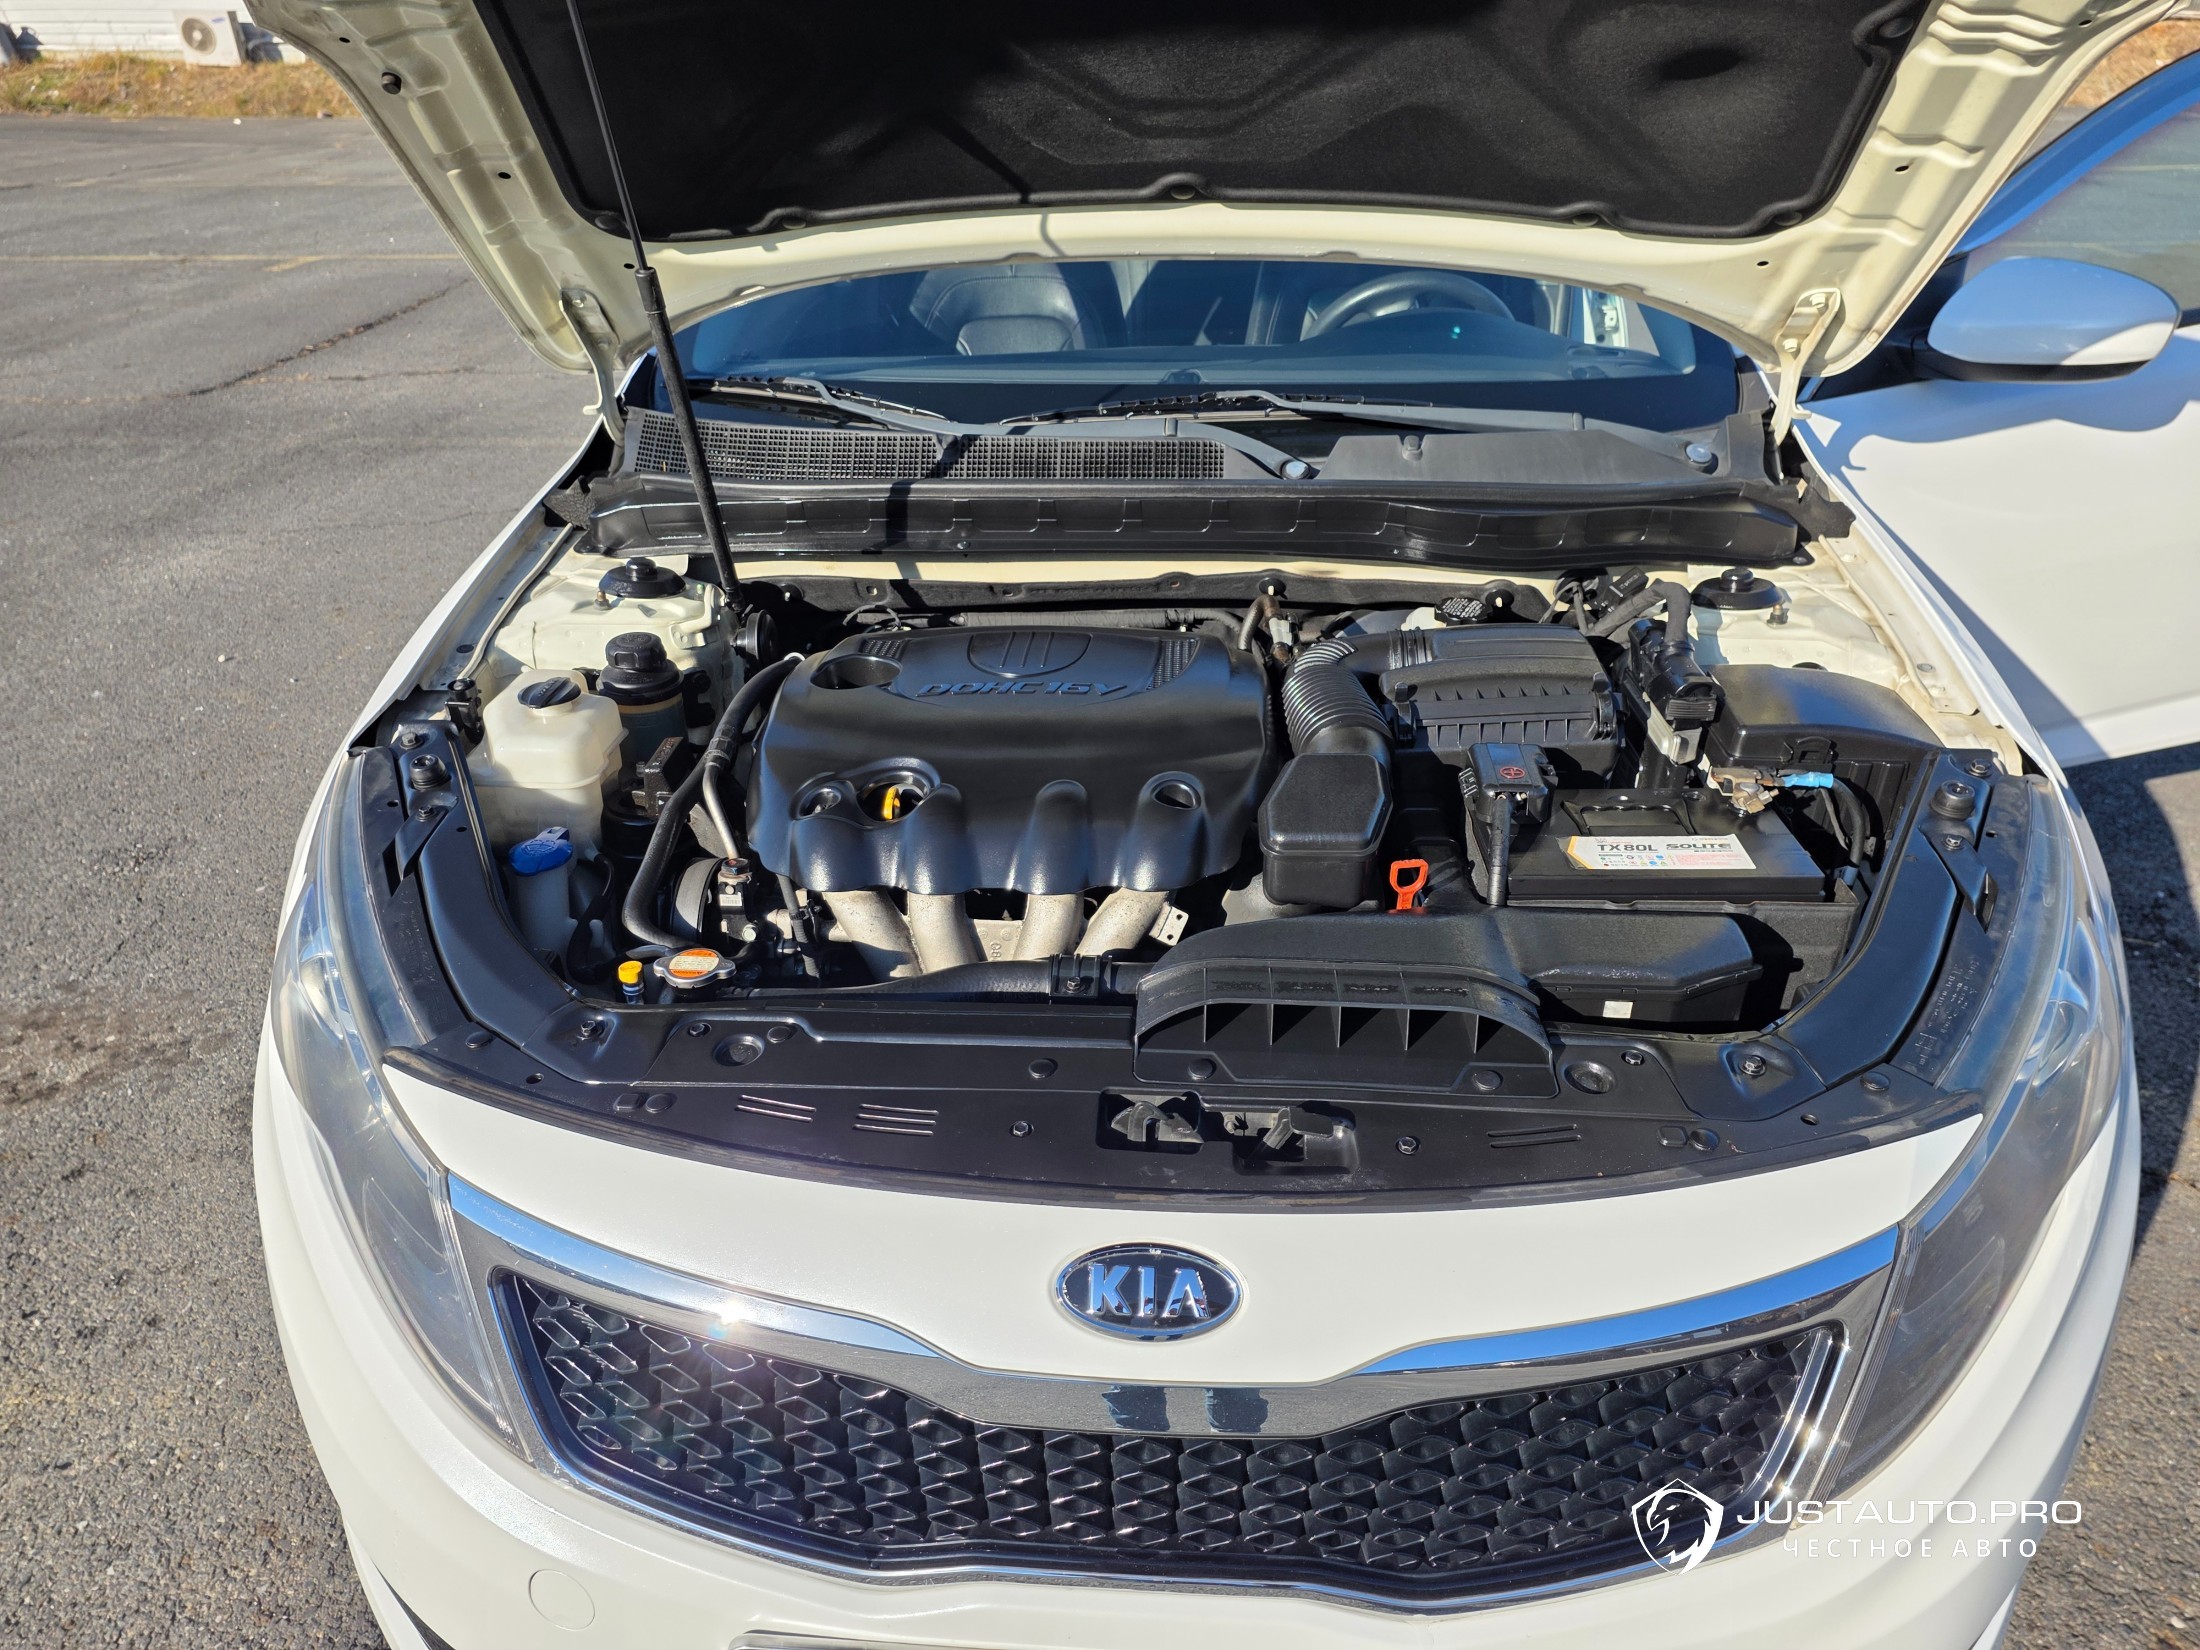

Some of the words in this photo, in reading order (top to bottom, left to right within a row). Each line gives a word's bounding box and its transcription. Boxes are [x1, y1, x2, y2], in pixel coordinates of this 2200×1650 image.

[915, 682, 1043, 697] DOHC
[1045, 682, 1127, 695] 16V
[1088, 1262, 1211, 1318] KIA
